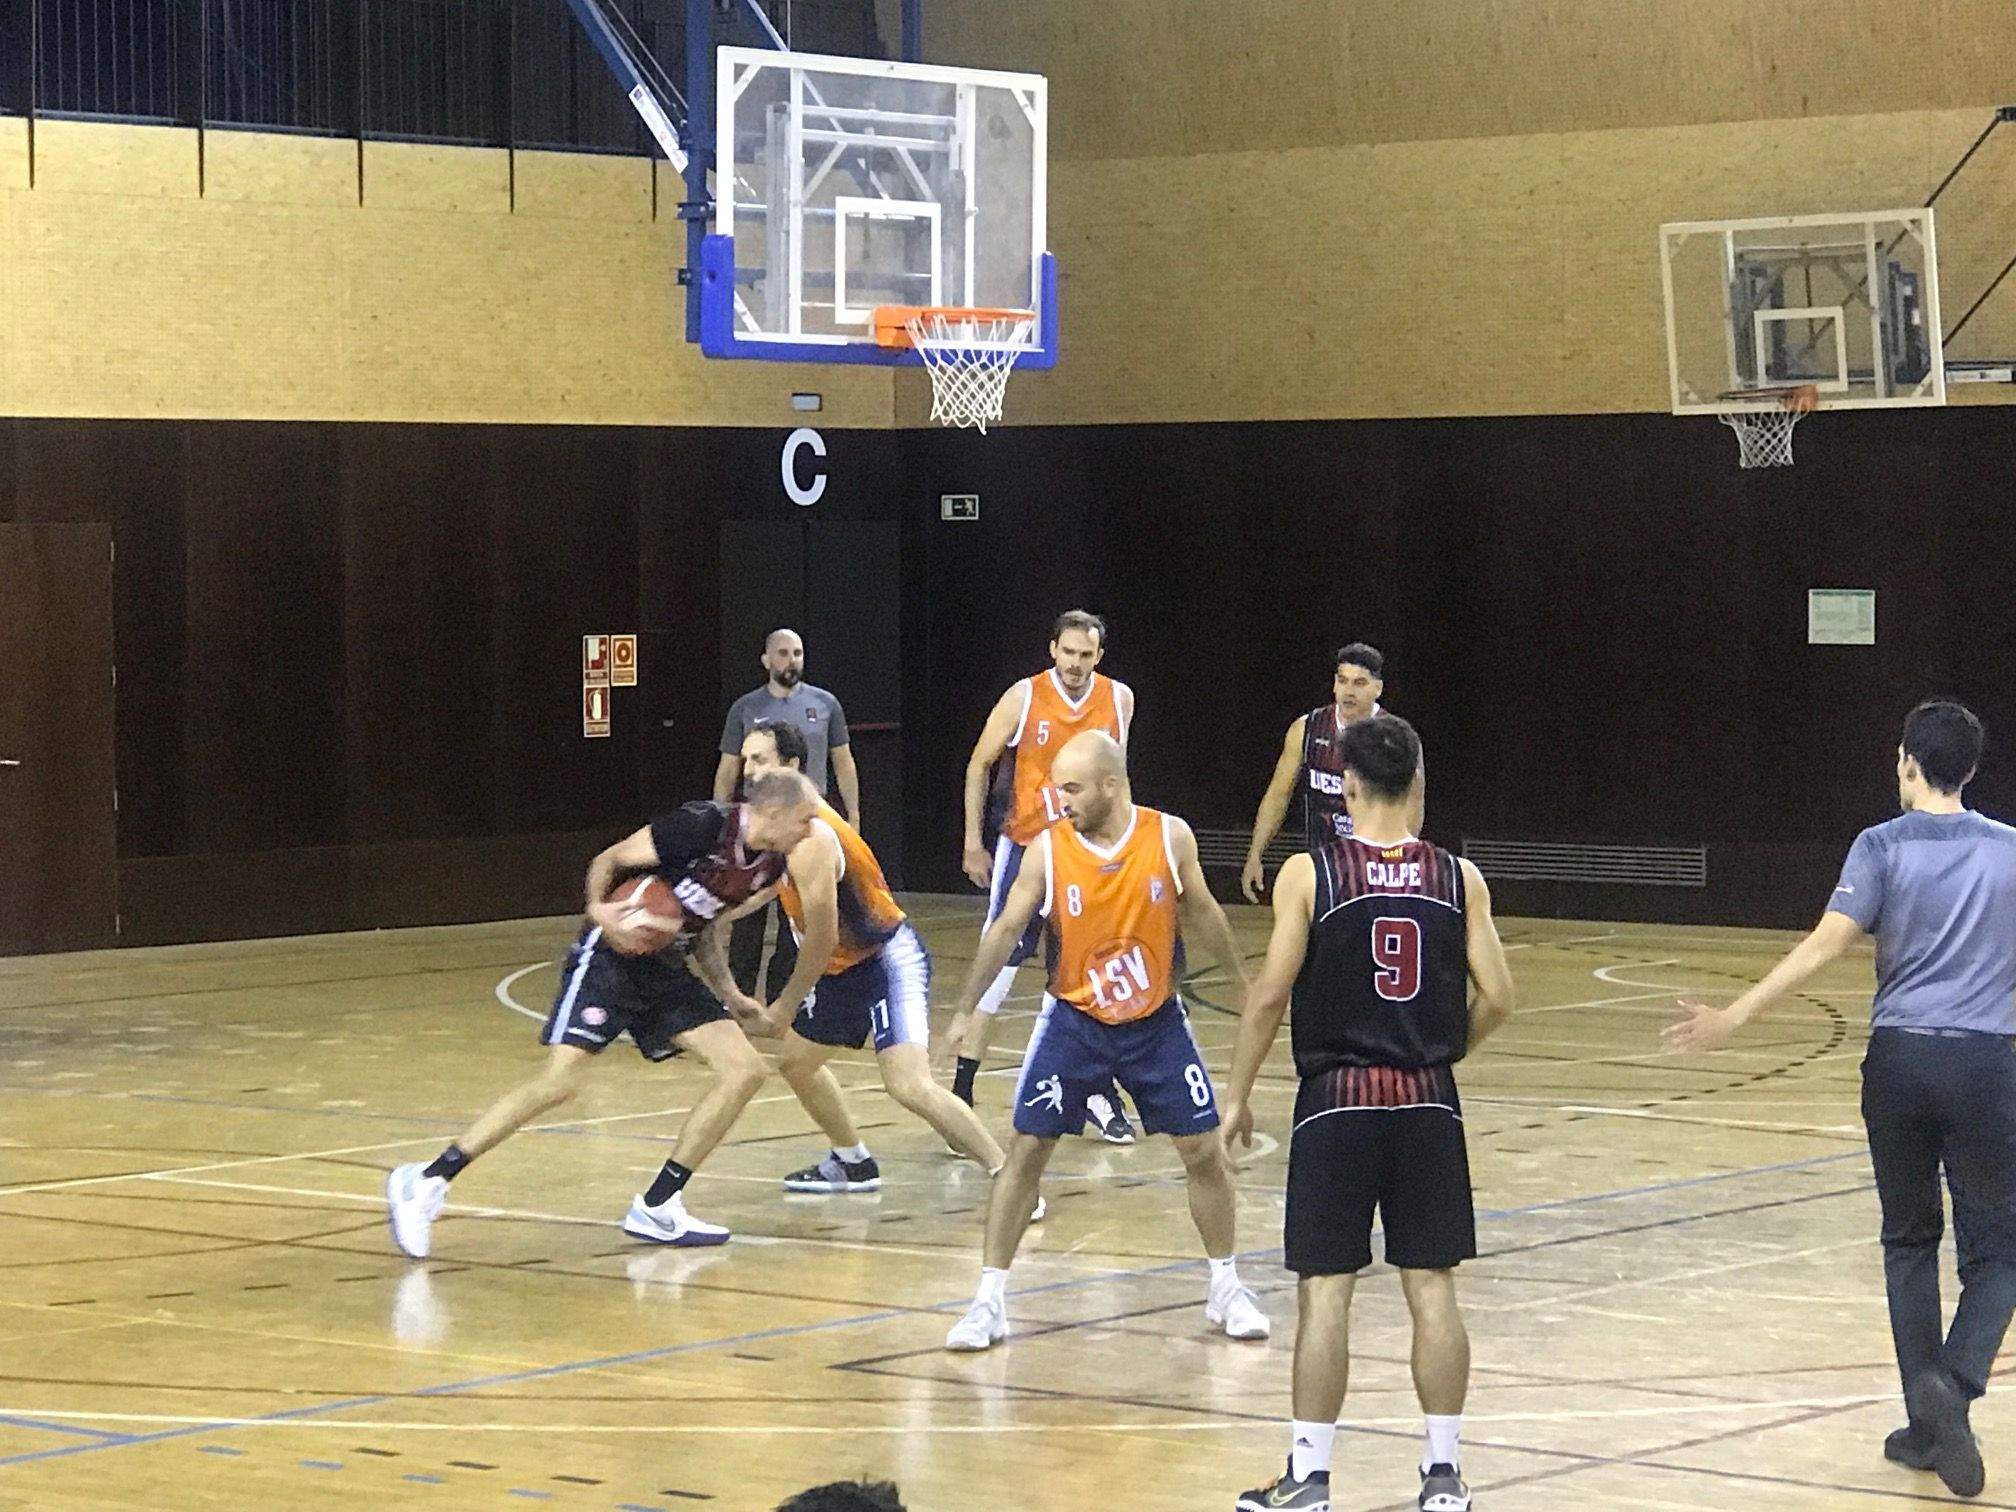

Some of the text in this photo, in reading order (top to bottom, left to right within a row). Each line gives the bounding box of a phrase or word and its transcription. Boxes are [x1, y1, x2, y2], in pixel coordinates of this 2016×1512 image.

[782, 428, 827, 506] C
[1036, 721, 1050, 746] 5
[1366, 861, 1422, 887] CALPE
[1066, 884, 1083, 917] 8
[1087, 945, 1150, 1009] LSV
[1371, 916, 1421, 1002] 9
[1184, 1063, 1210, 1107] 8
